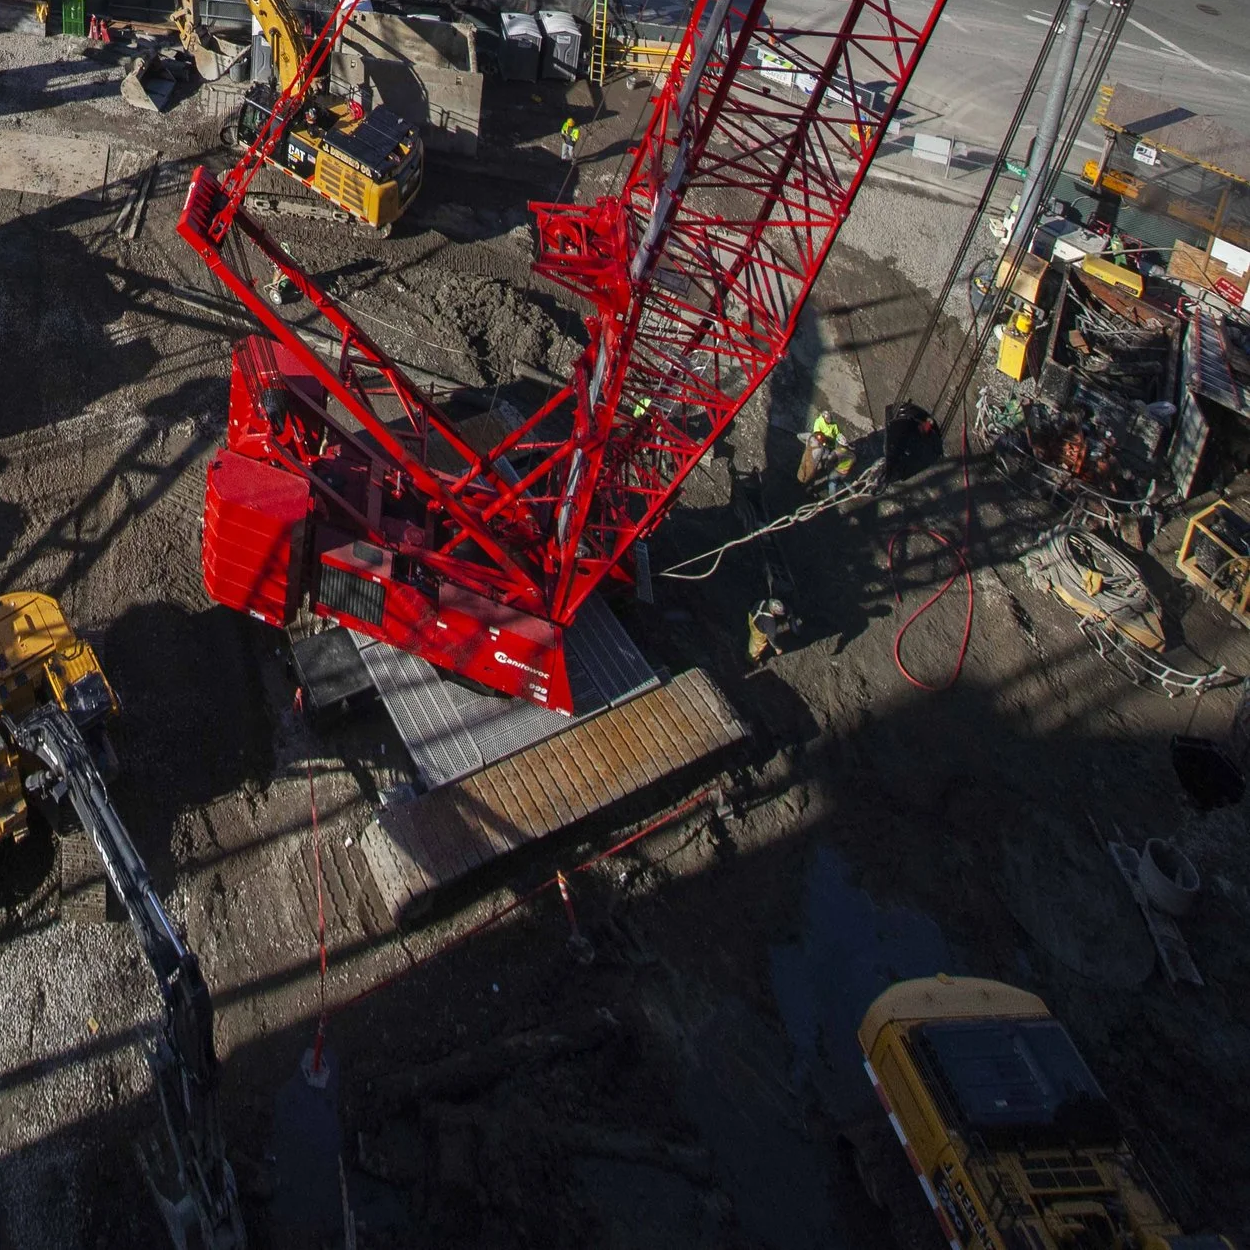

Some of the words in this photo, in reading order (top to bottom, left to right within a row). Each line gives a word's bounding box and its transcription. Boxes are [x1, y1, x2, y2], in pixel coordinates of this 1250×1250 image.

[288, 143, 306, 163] CAT
[330, 148, 360, 170] DERENZO
[494, 651, 550, 680] Manitowoc
[529, 683, 548, 694] 999
